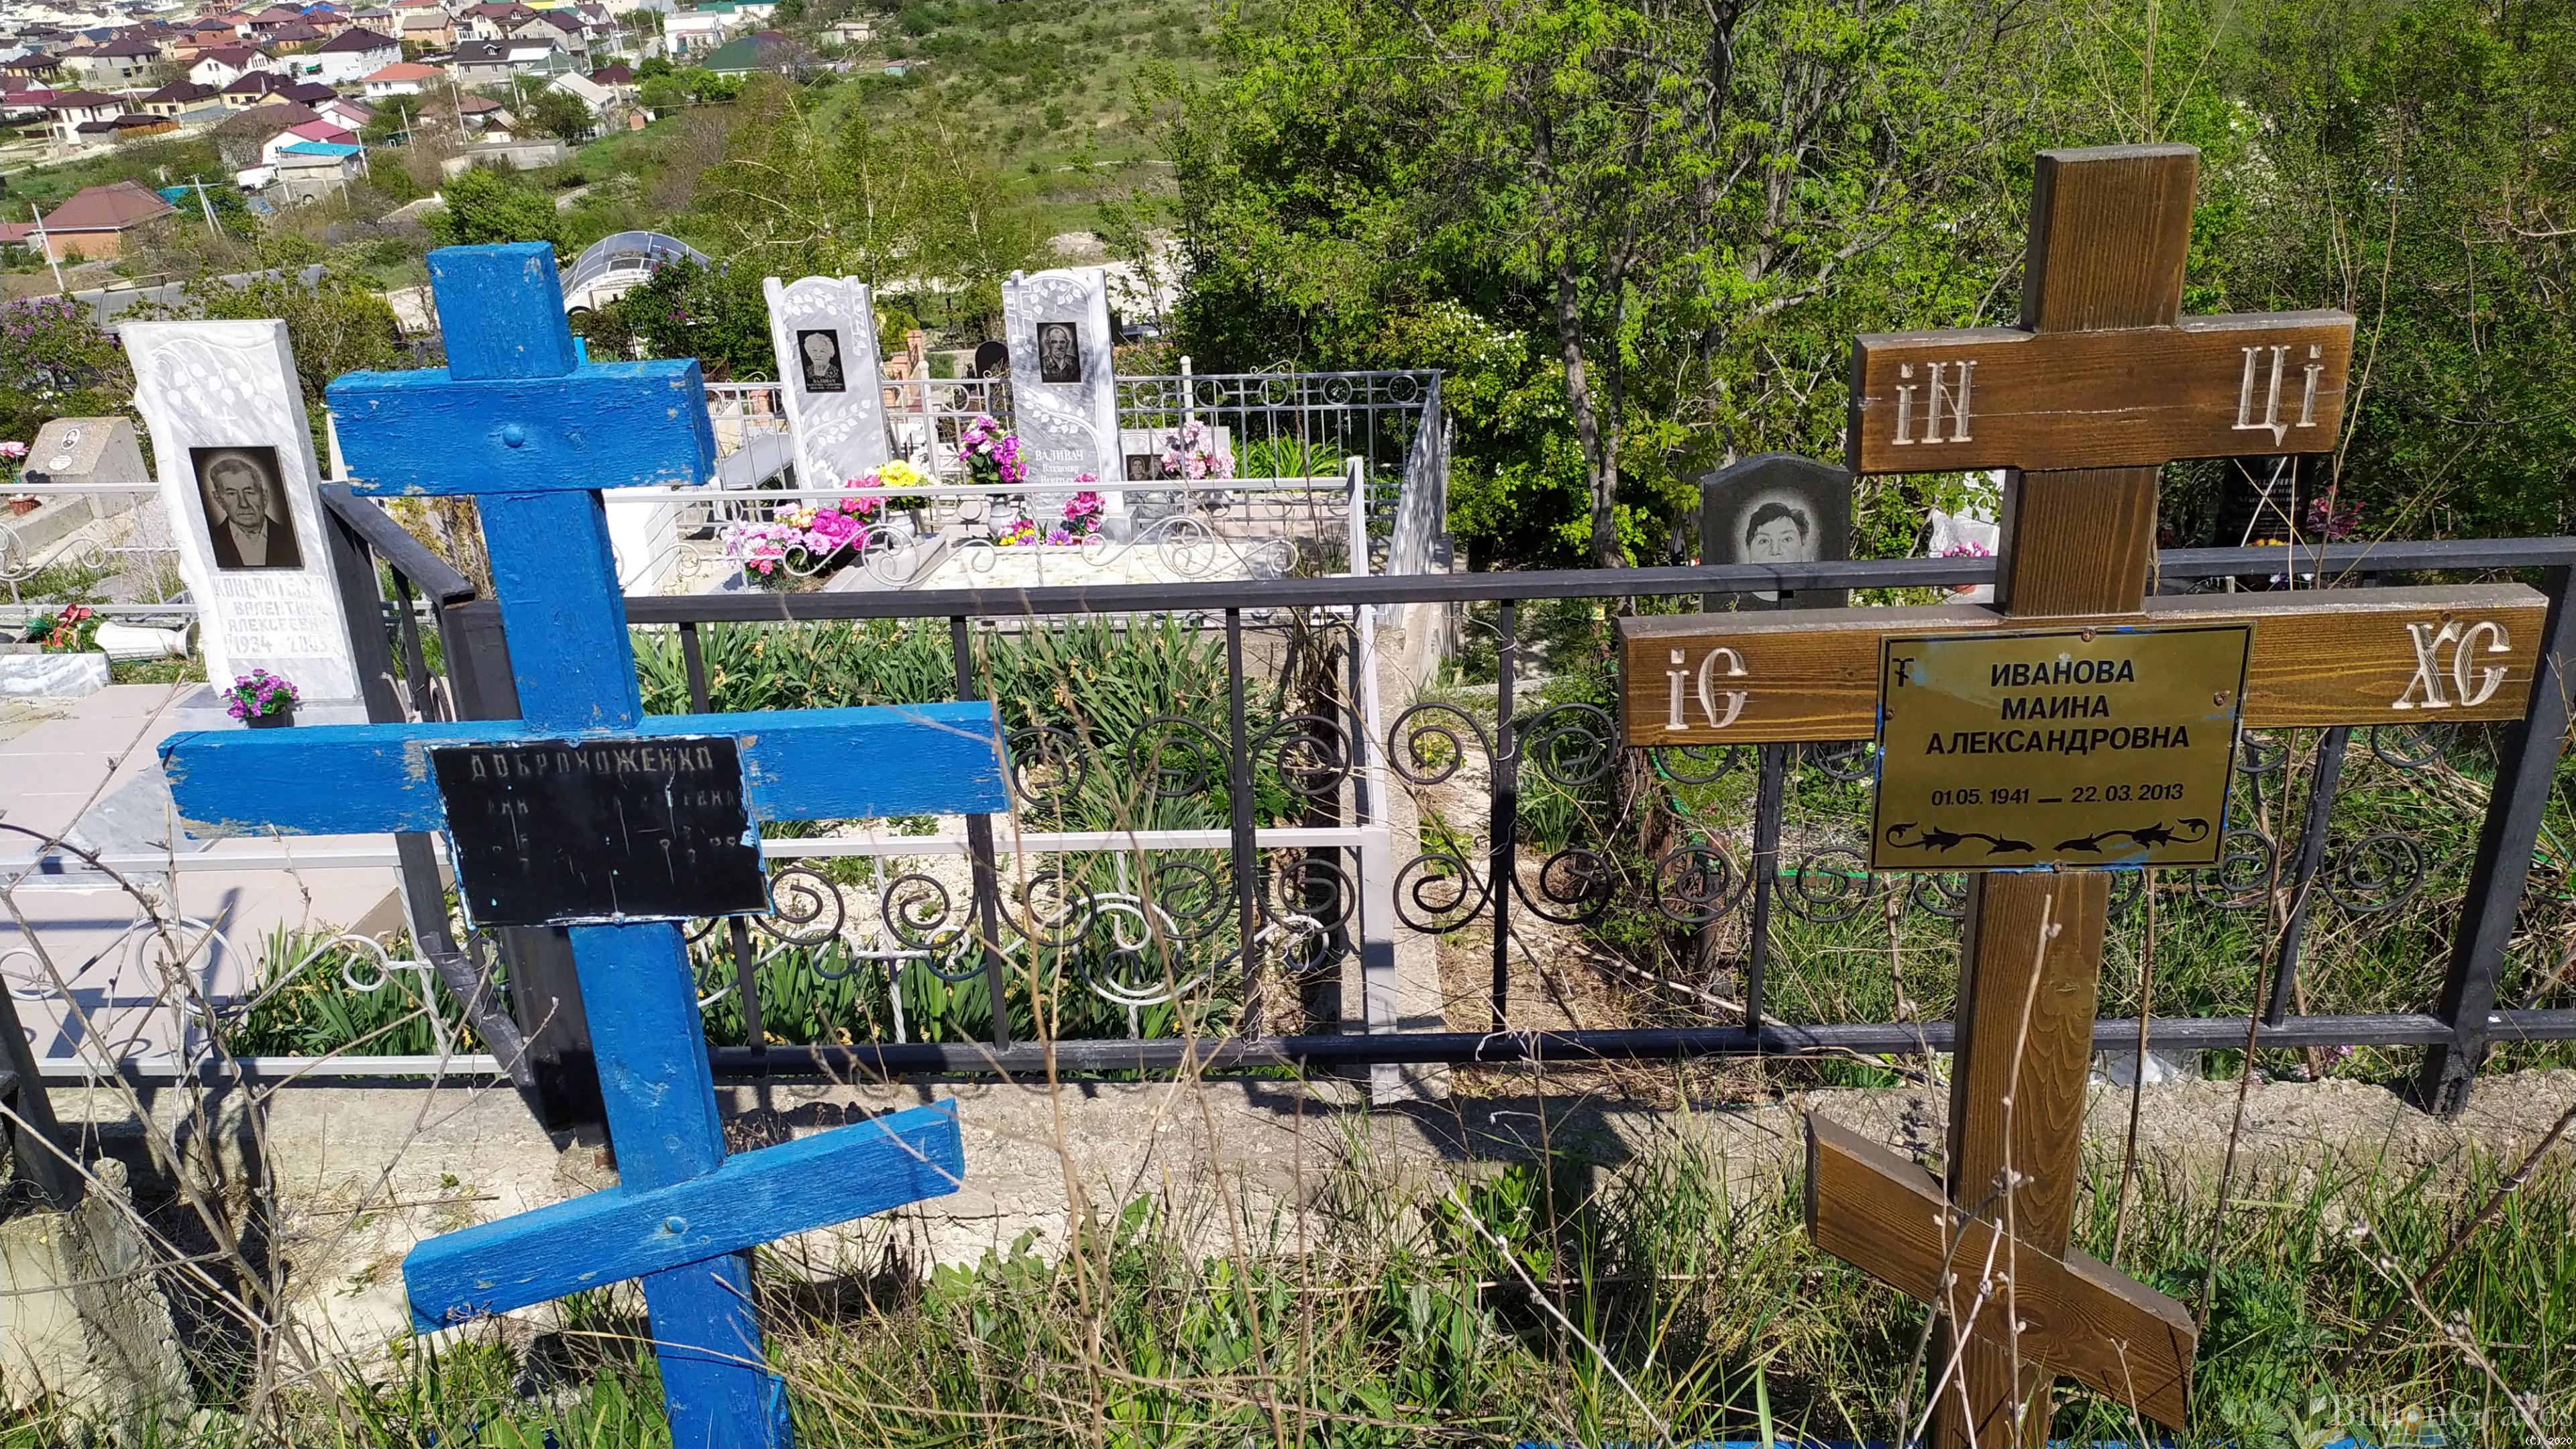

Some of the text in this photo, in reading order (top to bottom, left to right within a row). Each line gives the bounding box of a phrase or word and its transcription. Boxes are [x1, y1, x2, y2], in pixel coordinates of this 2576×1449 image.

[1035, 449, 1083, 461] ВАЛИВАЧ
[1990, 659, 2135, 687] ИВАНОВА
[2001, 694, 2110, 720] МАИНА
[1925, 726, 2189, 755] АЛЕКСАНДРОВНА
